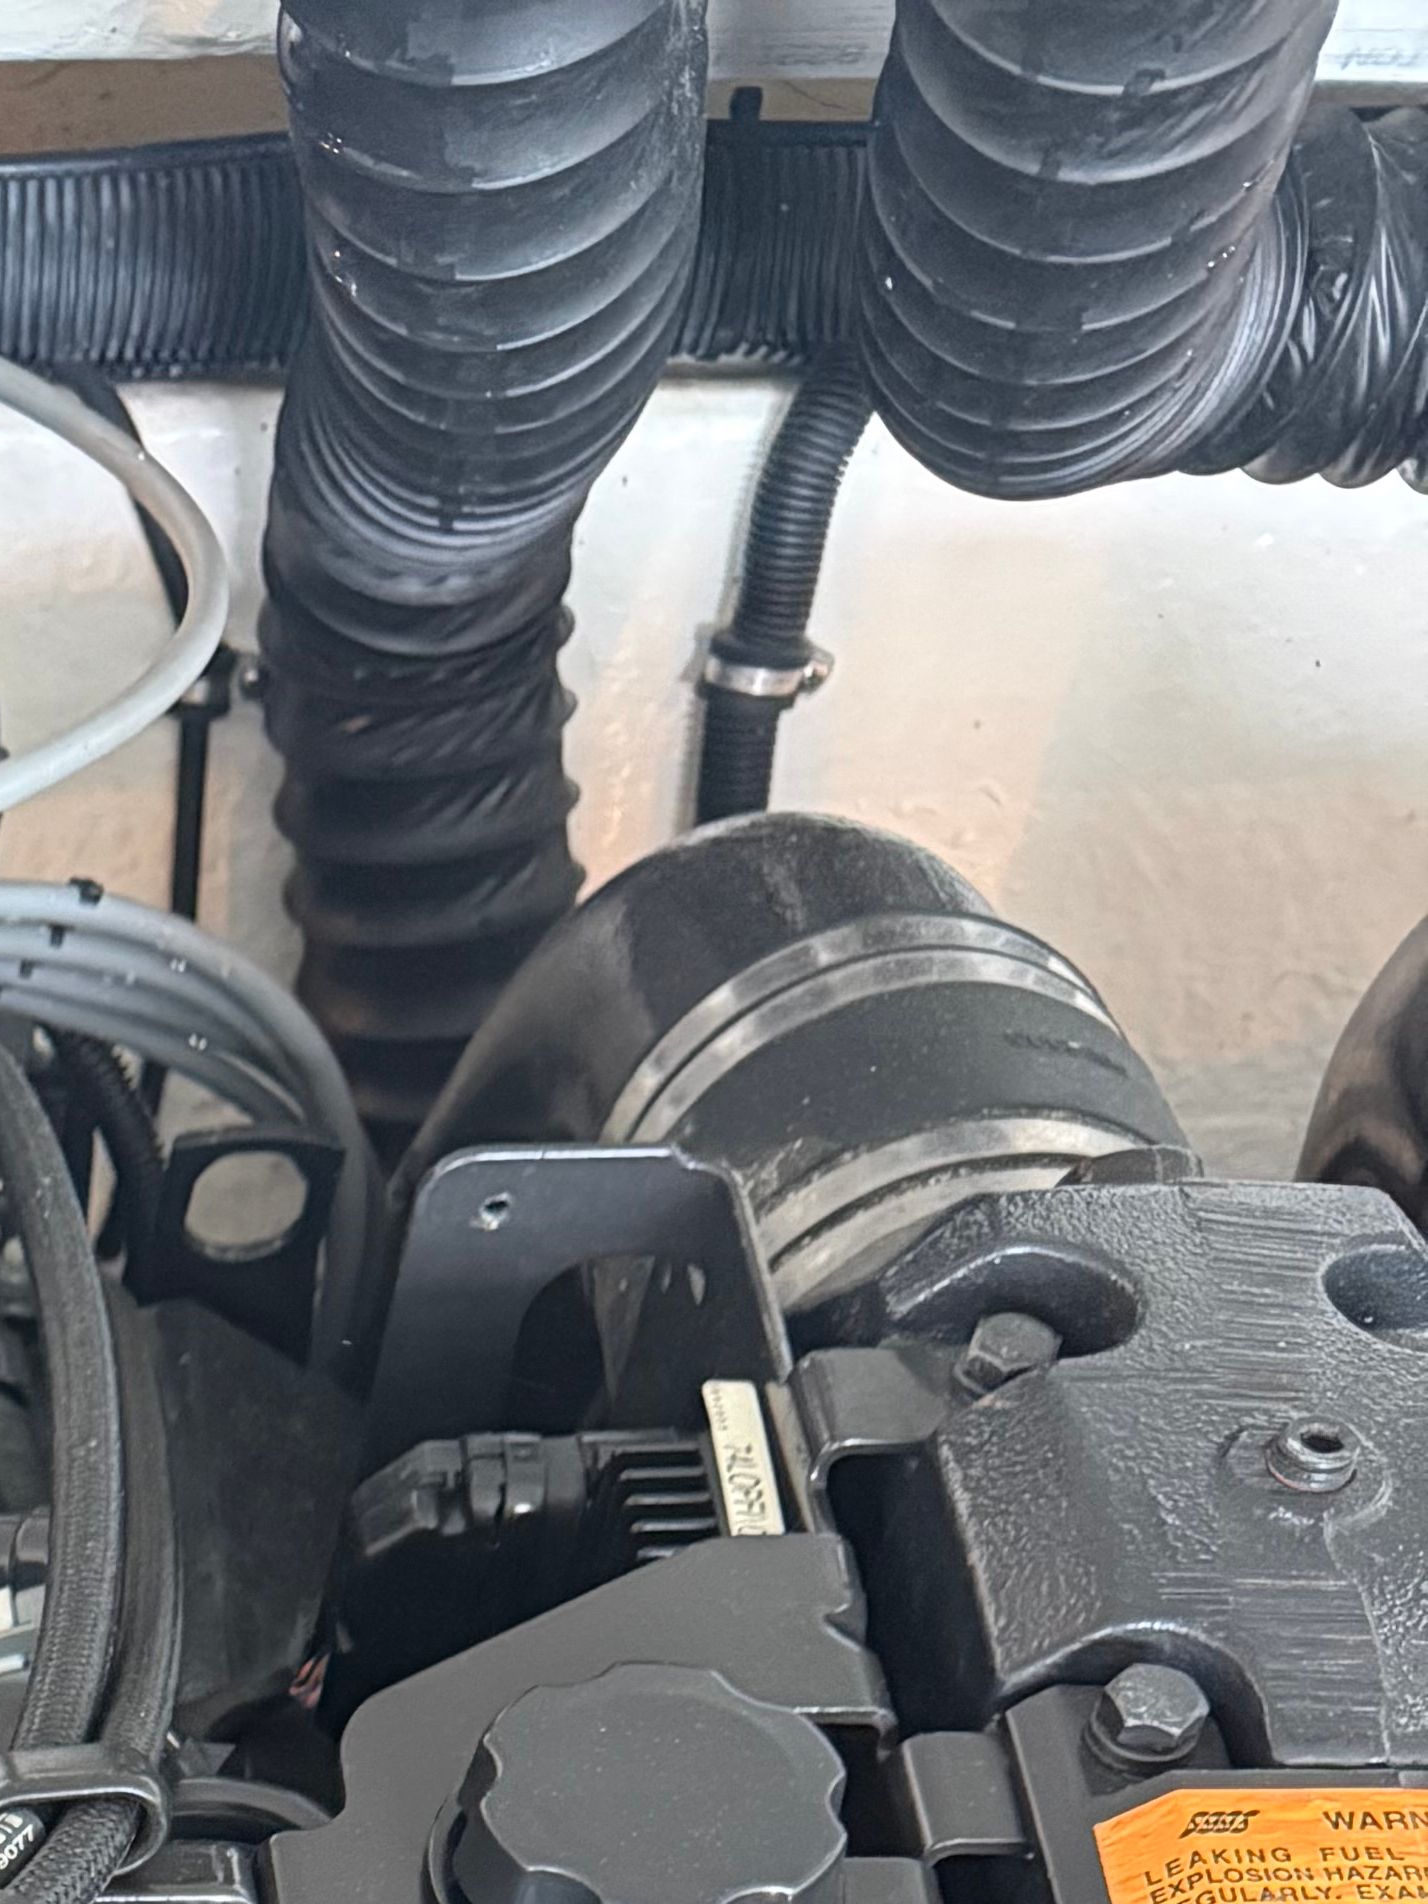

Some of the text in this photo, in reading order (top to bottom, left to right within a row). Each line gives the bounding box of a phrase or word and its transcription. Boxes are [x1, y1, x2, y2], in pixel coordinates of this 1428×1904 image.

[1145, 1846, 1405, 1887] LEAKING FUEL
[1323, 1865, 1428, 1881] HAZAR
